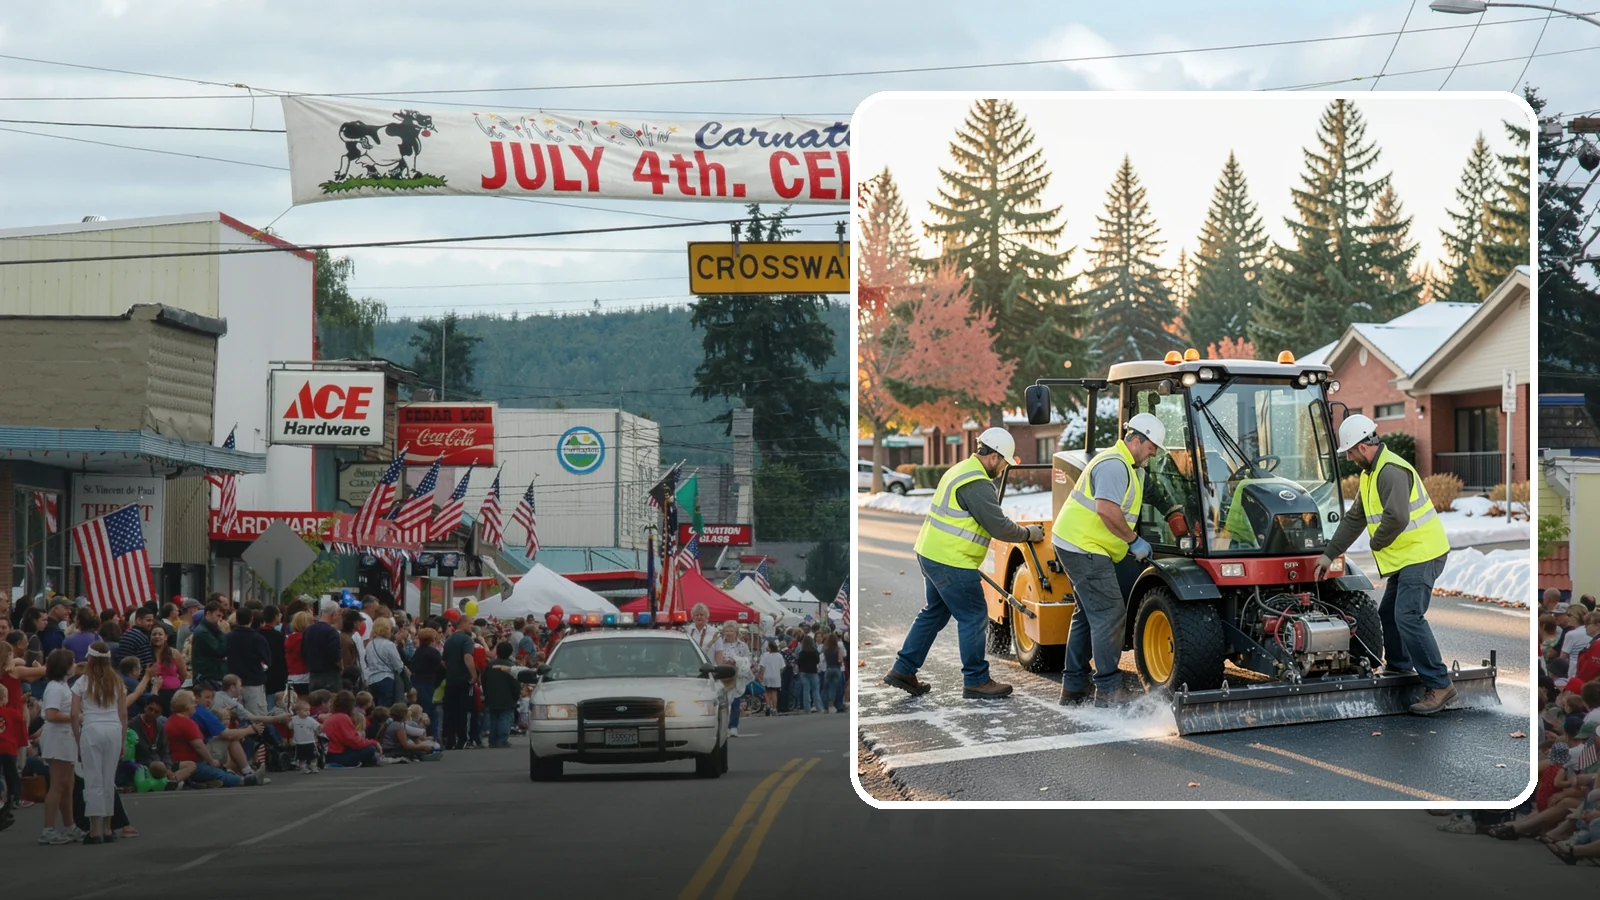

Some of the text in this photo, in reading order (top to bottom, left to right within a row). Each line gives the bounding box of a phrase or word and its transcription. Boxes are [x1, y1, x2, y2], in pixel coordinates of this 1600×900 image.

[481, 141, 605, 192] JULY
[632, 150, 746, 198] 4th.
[697, 254, 850, 280] CROSSWA
[283, 380, 373, 419] ACE
[405, 409, 453, 421] CEDAR
[284, 421, 371, 436] Hardware
[416, 428, 477, 446] Coca-Cola
[83, 485, 155, 495] St. Vincent de Paul
[213, 516, 331, 535] HARDARE
[688, 526, 741, 535] CRNATION
[699, 535, 730, 543] GLASS
